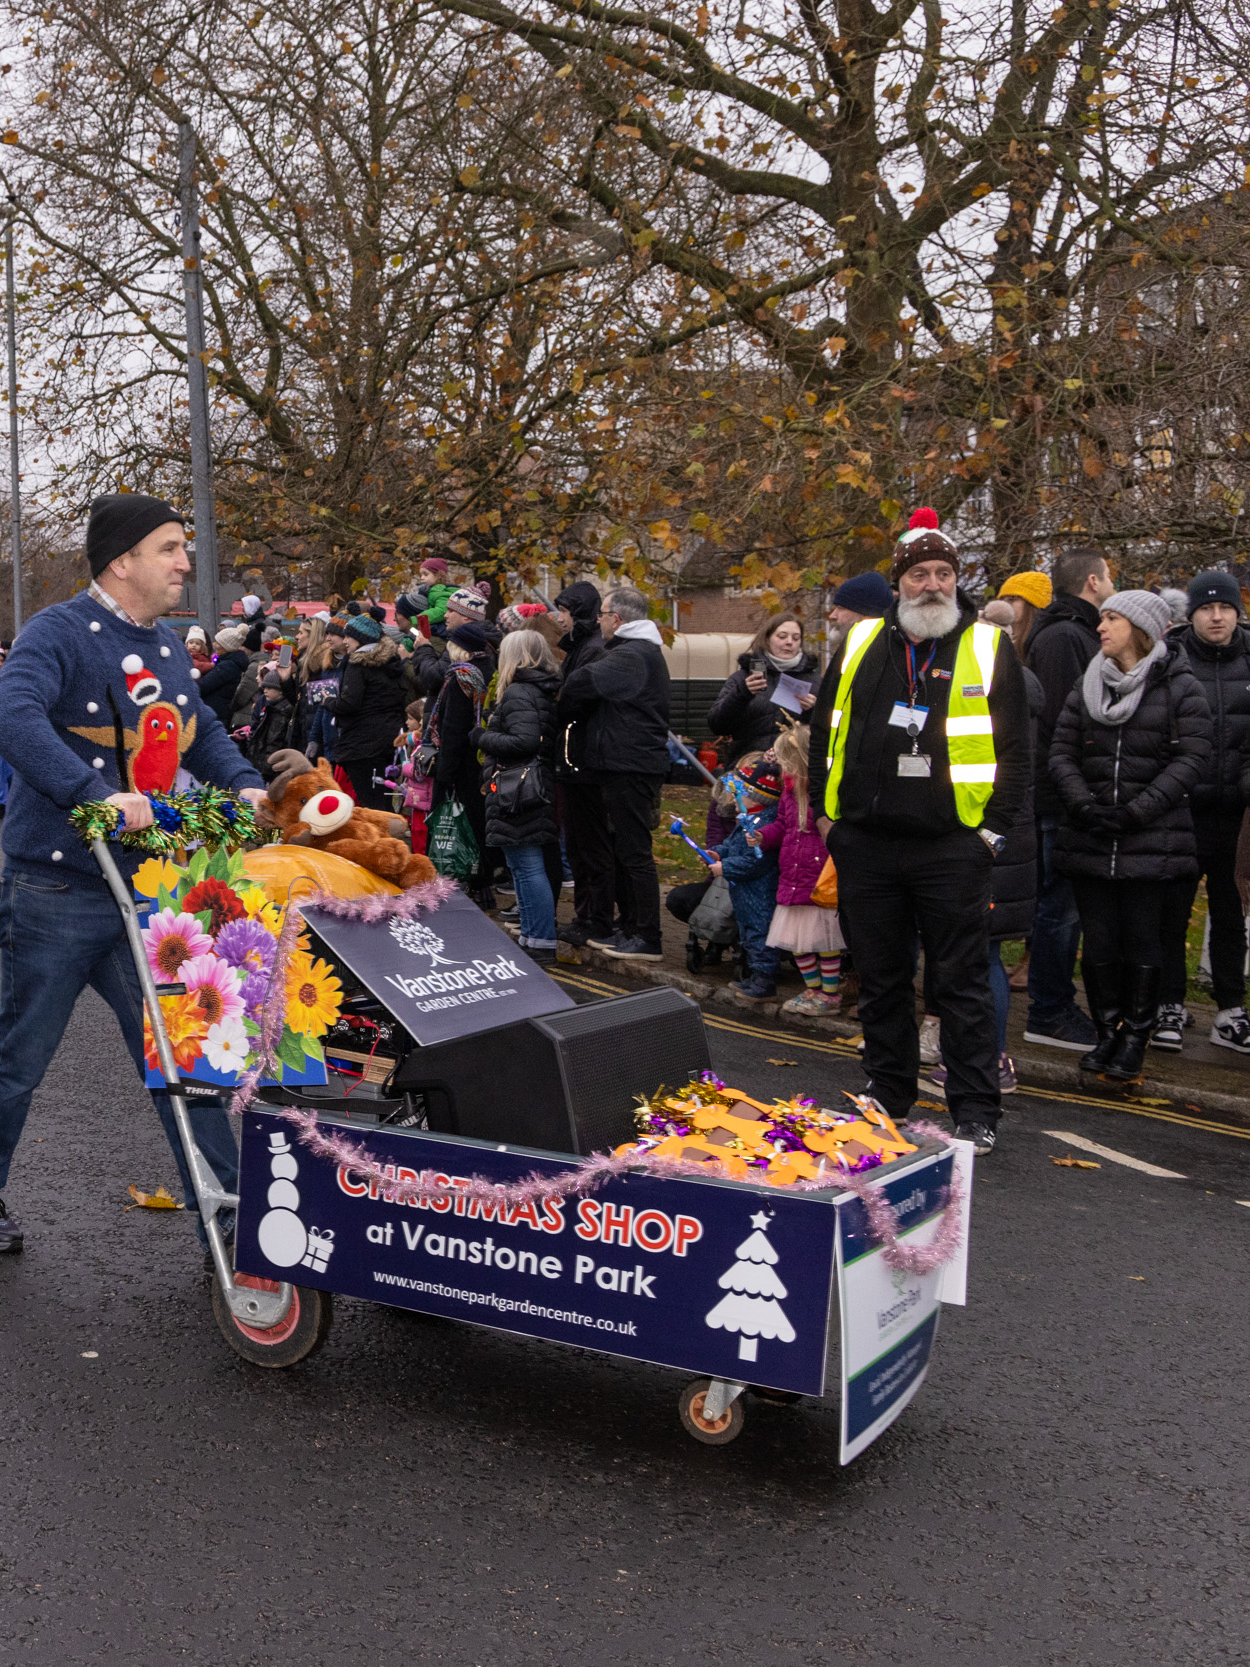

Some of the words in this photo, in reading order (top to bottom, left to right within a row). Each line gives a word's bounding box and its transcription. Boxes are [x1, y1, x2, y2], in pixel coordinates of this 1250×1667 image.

[384, 968, 487, 998] Vanstone
[471, 954, 528, 982] Park
[416, 995, 462, 1012] GARDEN
[458, 987, 500, 1004] CENTRE
[184, 1086, 220, 1096] THULE
[575, 1198, 703, 1257] SHOP
[366, 1223, 395, 1246] at
[402, 1221, 563, 1279] Vanstone
[574, 1255, 657, 1298] Park
[373, 1271, 638, 1336] www.vanstoneparkgardencentre.co.uk
